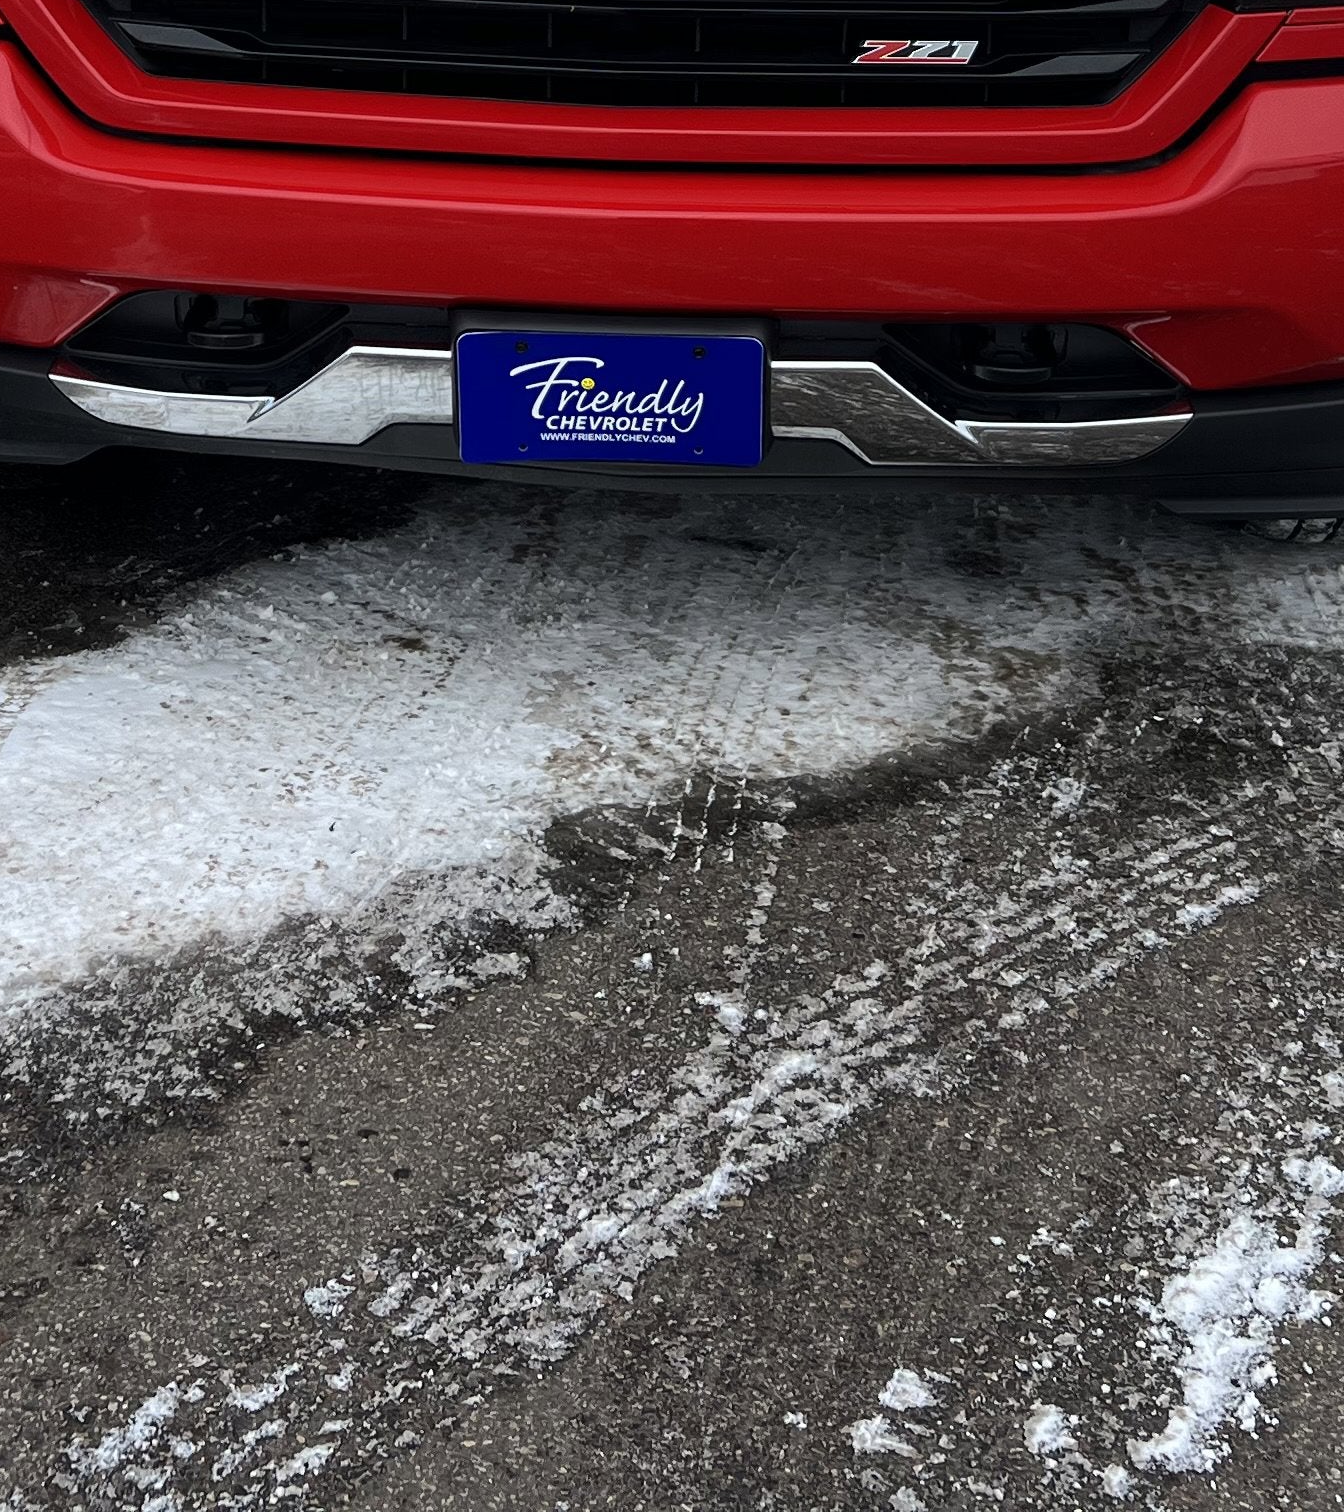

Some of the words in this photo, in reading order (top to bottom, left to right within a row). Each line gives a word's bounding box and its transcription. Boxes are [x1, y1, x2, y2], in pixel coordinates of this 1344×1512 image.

[851, 40, 979, 64] Z71
[509, 356, 704, 433] Friendly
[546, 415, 668, 432] CHEVROLET
[540, 432, 676, 444] WWW.FRIENDLYCHEV.COM
